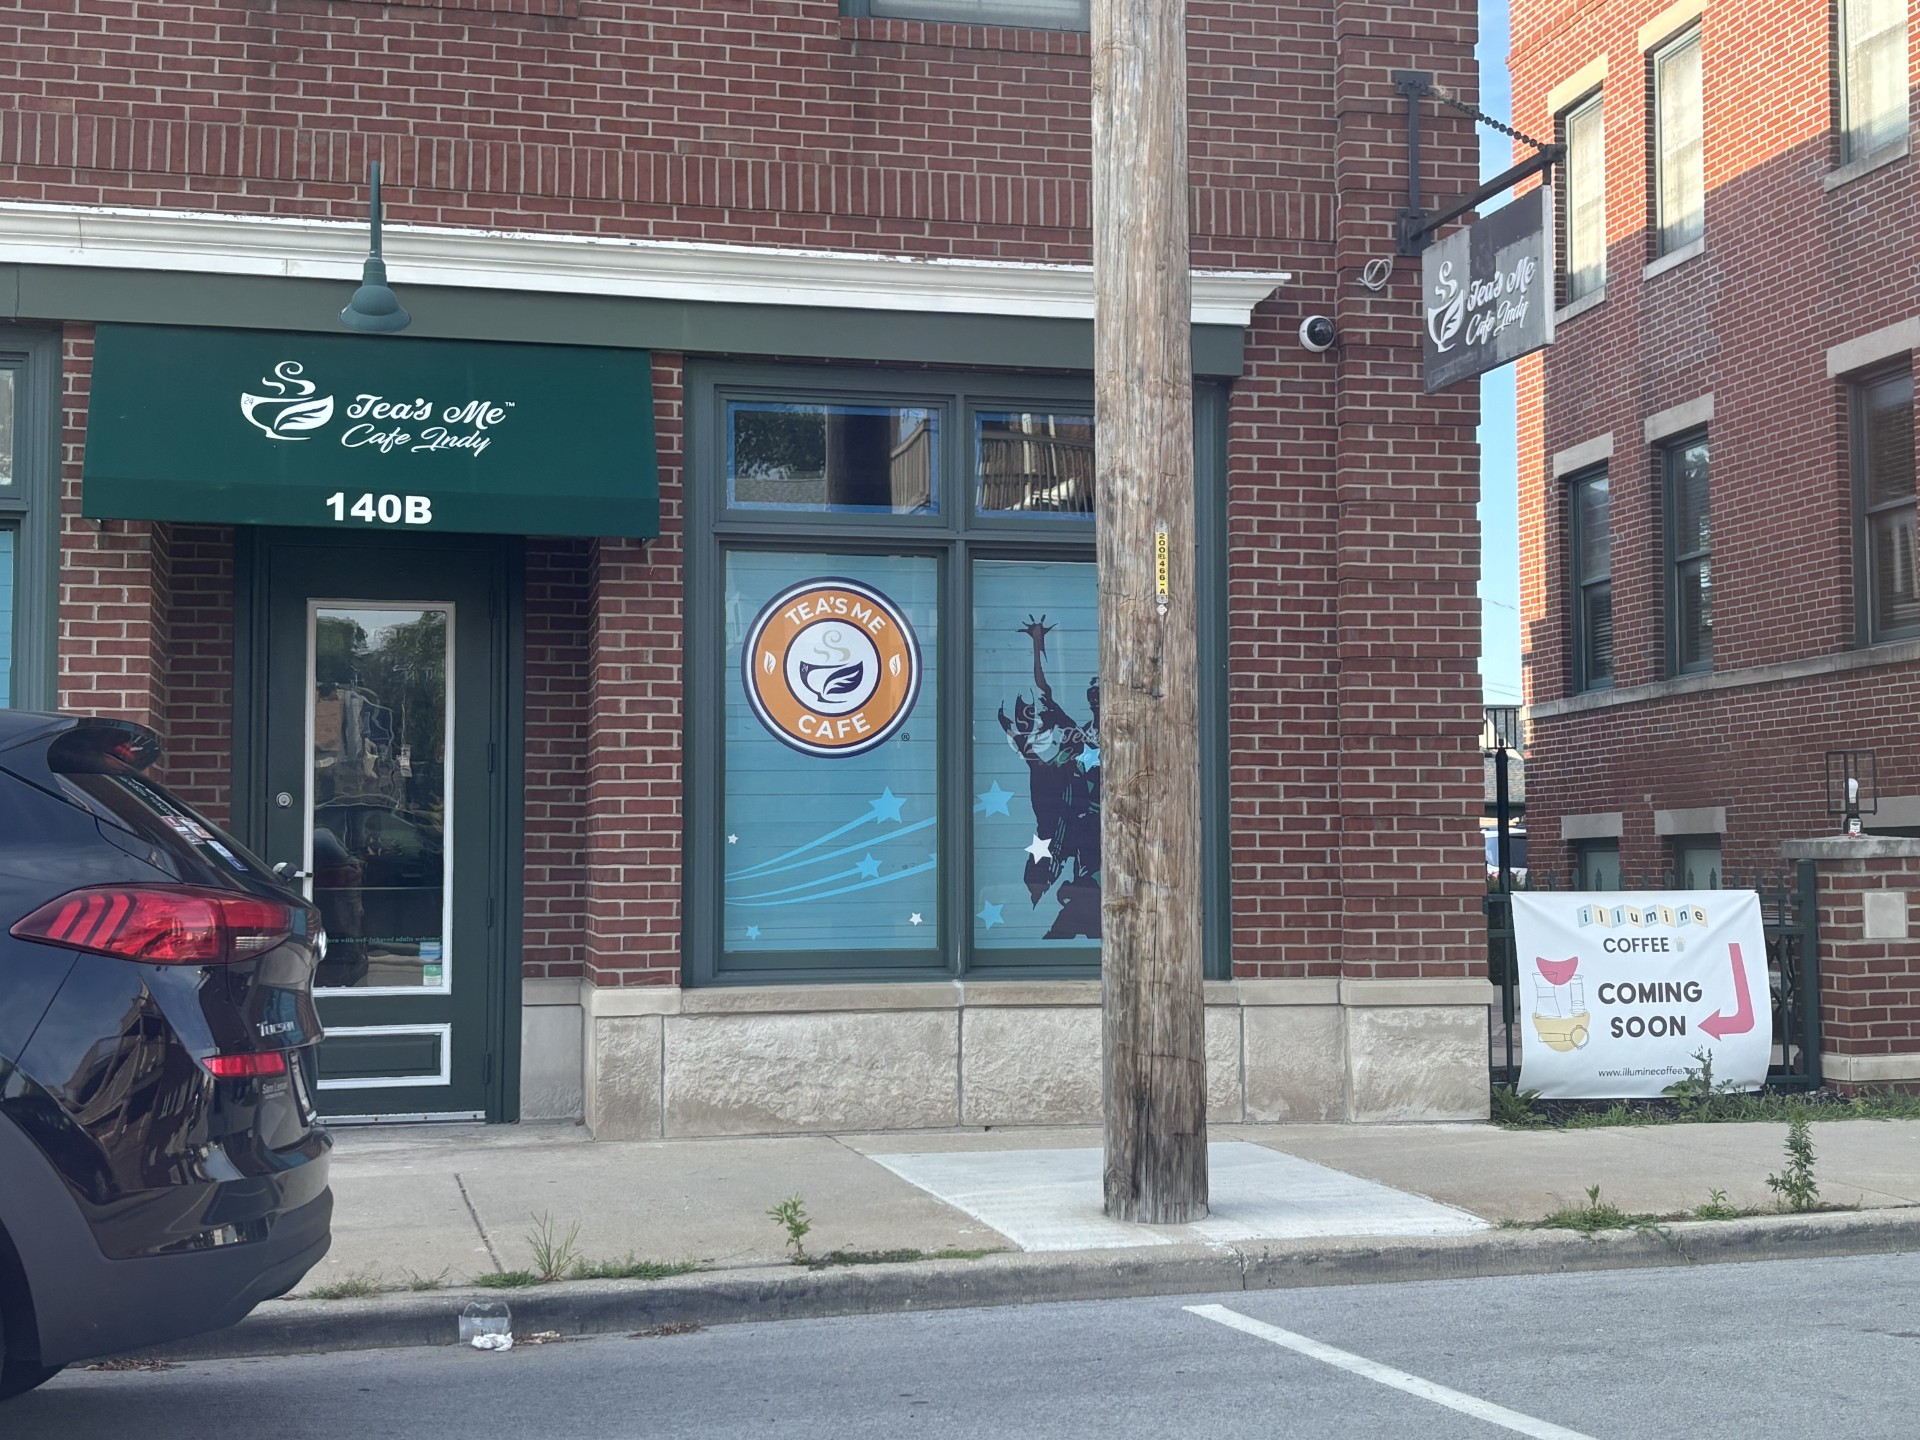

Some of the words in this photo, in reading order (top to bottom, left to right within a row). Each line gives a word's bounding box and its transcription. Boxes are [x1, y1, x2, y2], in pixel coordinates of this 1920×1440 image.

[1467, 270, 1503, 312] Tea's
[1507, 256, 1536, 293] Me
[1466, 310, 1496, 346] Cafe
[1493, 295, 1529, 337] Indy
[346, 393, 433, 421] Tea's
[443, 400, 506, 429] Me
[341, 423, 411, 454] Cafe
[411, 426, 492, 457] Indy
[326, 492, 433, 525] 140B
[784, 596, 848, 627] TEA'S
[851, 602, 887, 635] ME
[798, 712, 871, 740] CAFE
[1582, 909, 1704, 924] illumine
[1602, 937, 1670, 954] COFFEE
[1597, 980, 1703, 1005] COMING
[257, 1021, 295, 1037] Tucson
[1610, 1015, 1687, 1039] SOON
[1598, 1065, 1704, 1077] www.illuminecoffee.om
